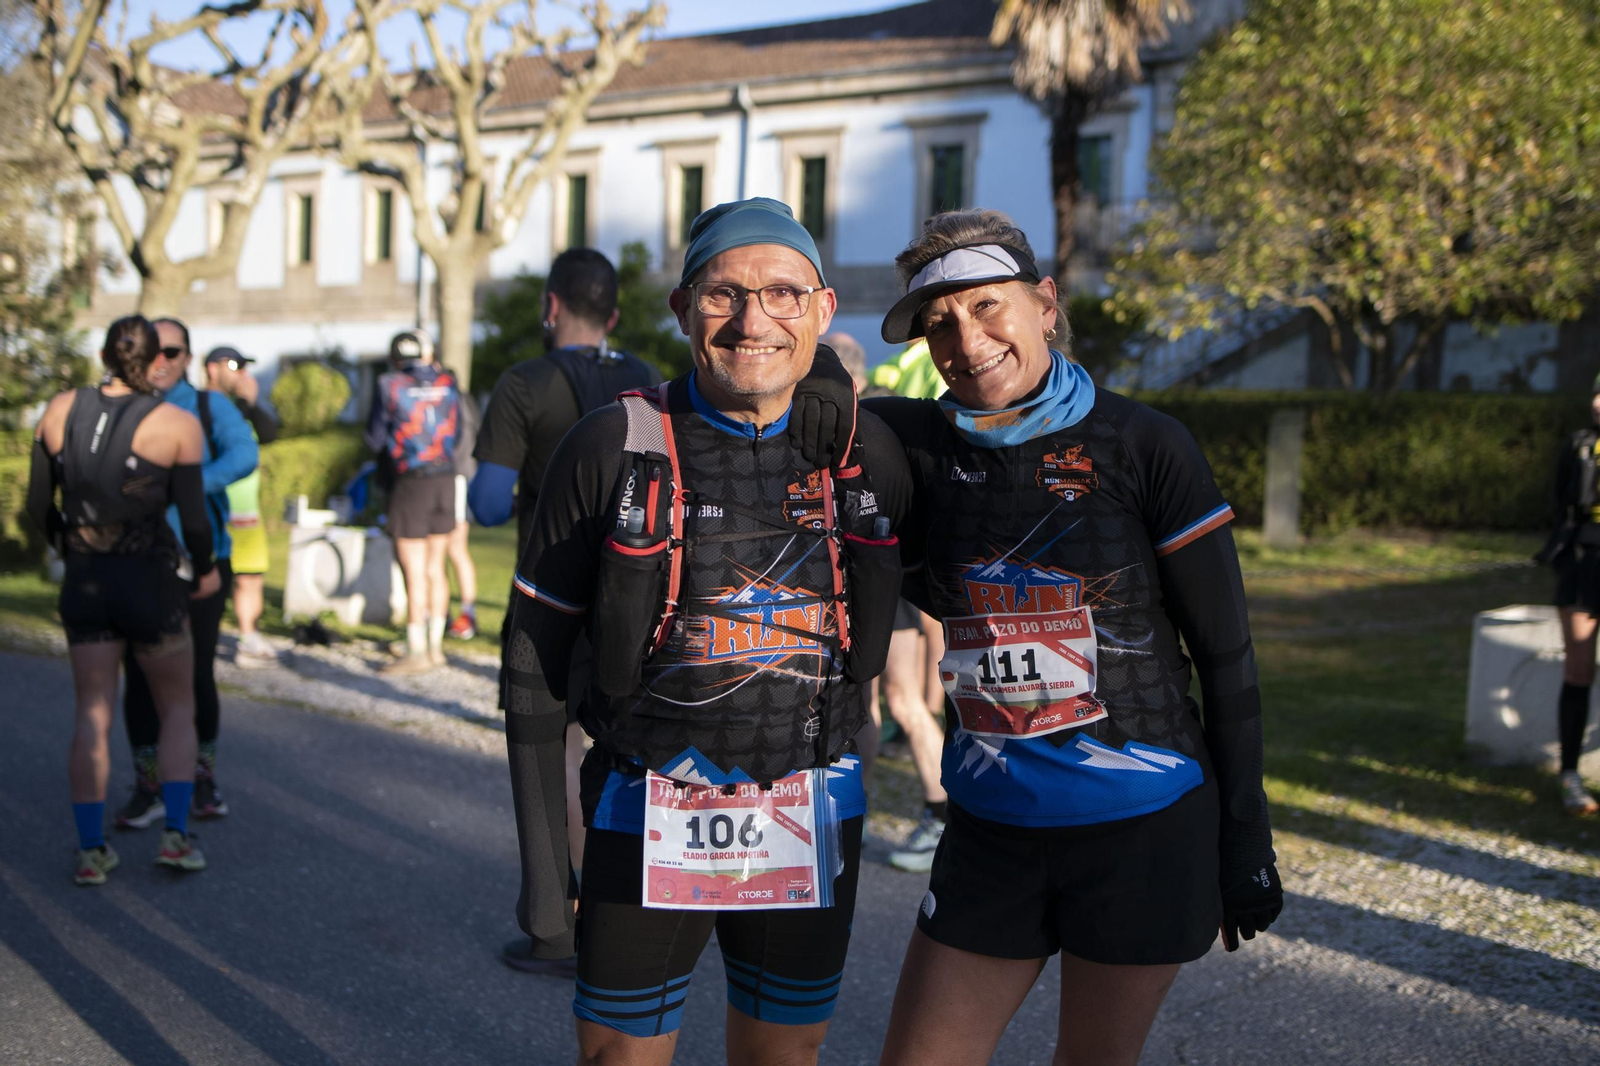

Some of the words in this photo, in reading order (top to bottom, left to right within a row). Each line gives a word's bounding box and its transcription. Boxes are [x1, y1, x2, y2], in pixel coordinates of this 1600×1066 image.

[966, 580, 1077, 616] RUN
[1064, 587, 1073, 610] ANIAK
[710, 602, 821, 656] RUN
[952, 626, 983, 641] TRAIL
[983, 621, 1018, 639] POZO
[1020, 621, 1040, 634] DO
[1043, 618, 1083, 632] DEMO
[978, 648, 1042, 685] 111
[979, 685, 991, 693] DEL
[991, 684, 1017, 694] CARMEN
[1018, 682, 1048, 692] ALVAREZ
[1049, 680, 1076, 690] SIERRA
[740, 783, 759, 799] DO
[685, 813, 764, 850] 106
[682, 851, 708, 861] ELADIO
[709, 851, 736, 861] GARCIA
